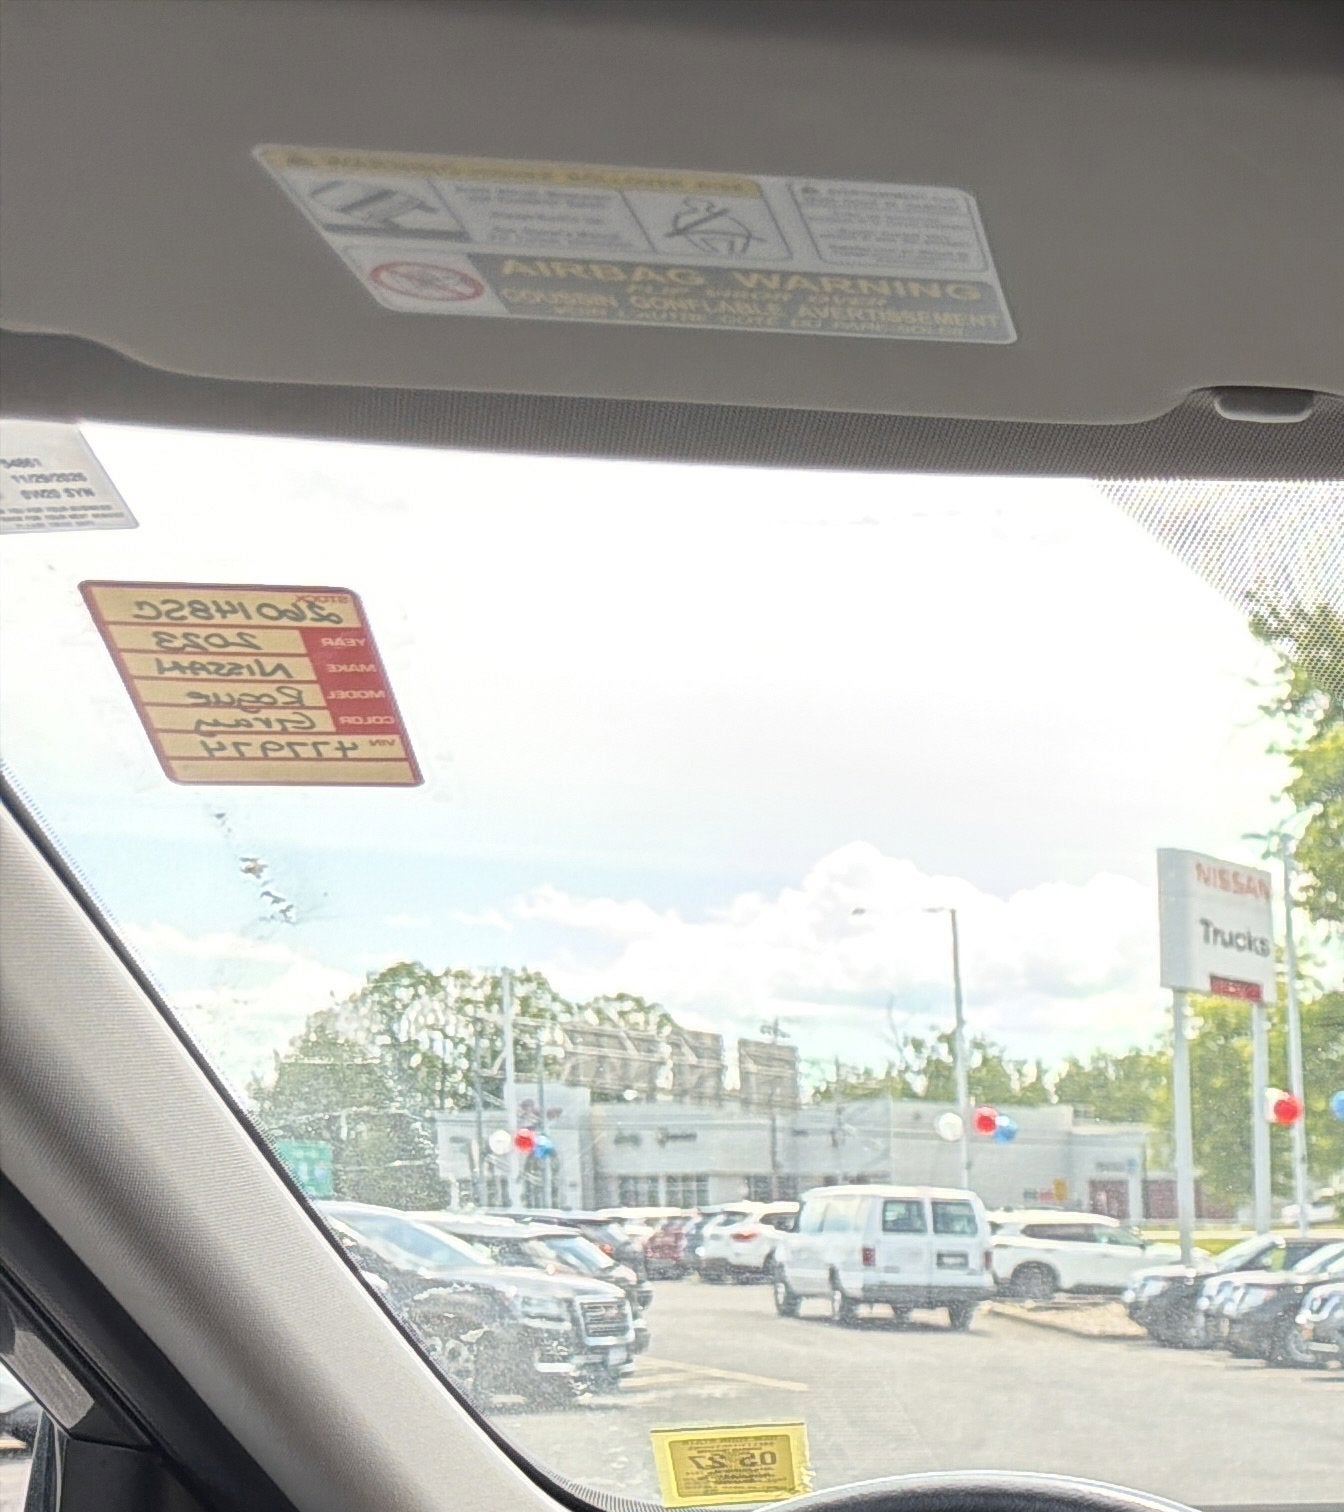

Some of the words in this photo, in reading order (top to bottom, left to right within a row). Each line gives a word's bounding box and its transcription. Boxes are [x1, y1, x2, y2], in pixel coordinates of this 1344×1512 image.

[500, 258, 707, 287] AIRBAG
[731, 272, 984, 302] WARNING
[63, 487, 96, 498] SYN
[1195, 862, 1272, 901] NISSAN
[1200, 917, 1271, 958] Trucks
